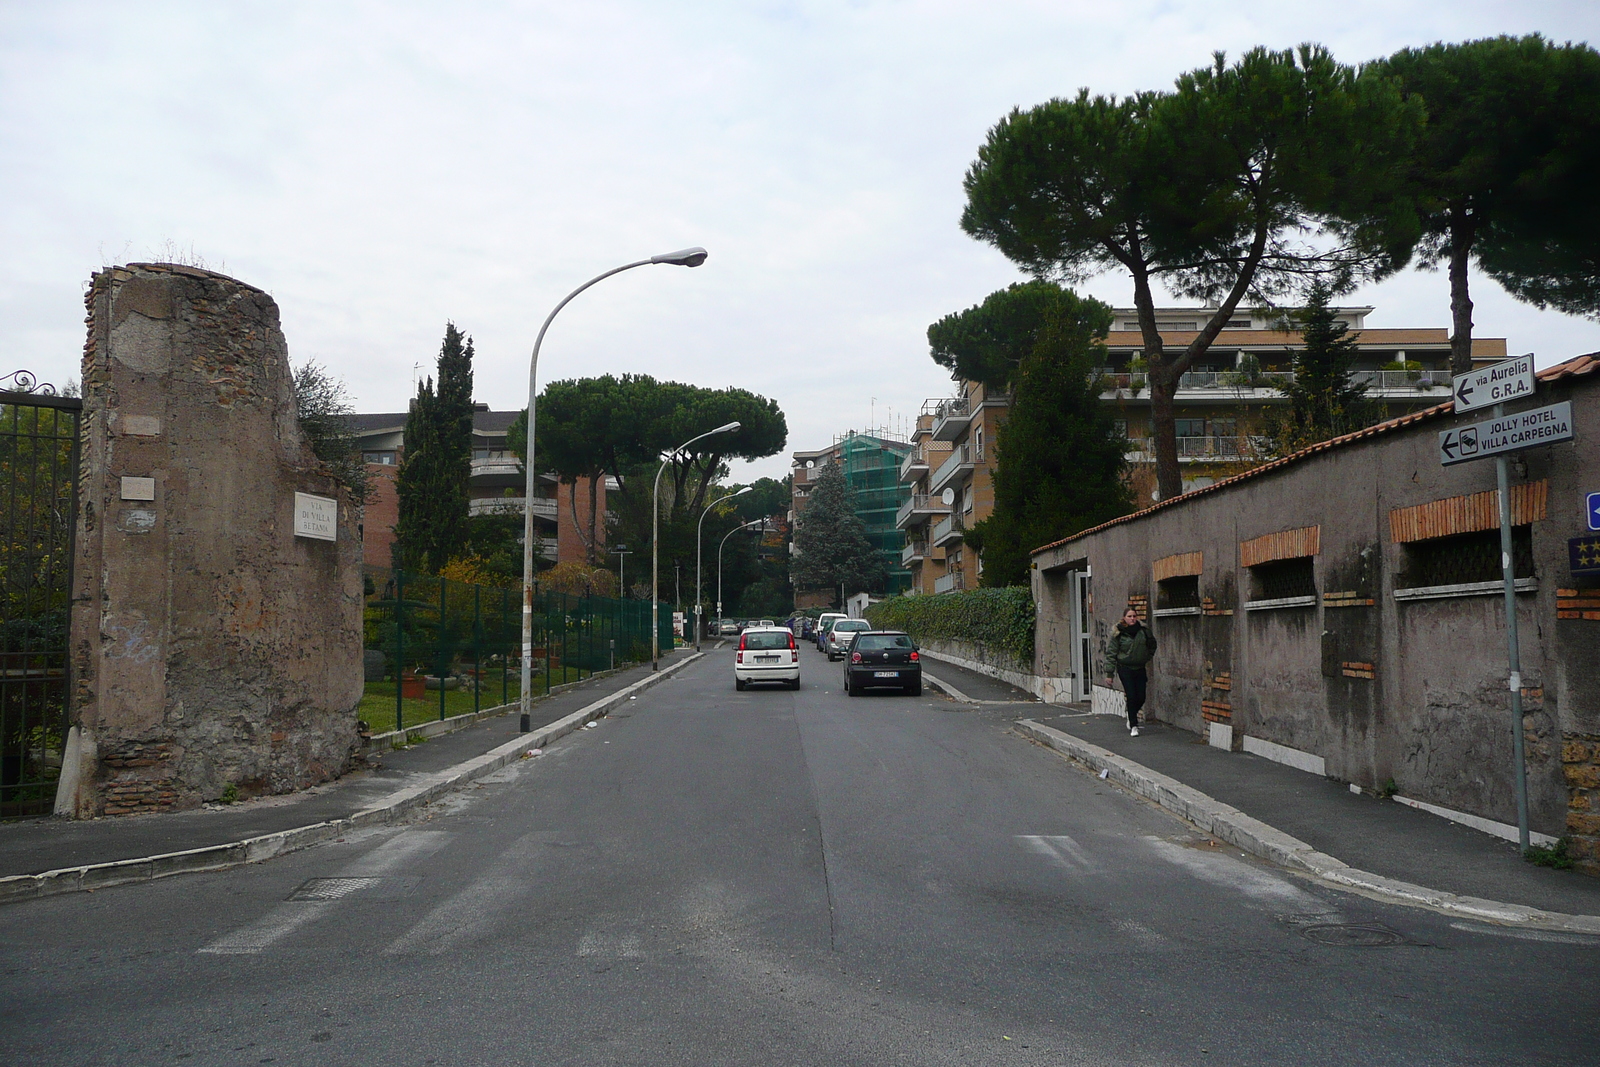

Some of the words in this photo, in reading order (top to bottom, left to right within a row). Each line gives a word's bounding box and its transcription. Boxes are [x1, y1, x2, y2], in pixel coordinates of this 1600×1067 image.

[1476, 375, 1488, 386] via
[1490, 361, 1528, 382] Aurelia
[1491, 380, 1529, 399] G.R.A.
[1490, 419, 1518, 434] JOLLY
[1522, 410, 1556, 427] HOTEL
[1481, 435, 1509, 450] VILLA
[1511, 422, 1568, 443] CARPEGNA
[302, 510, 309, 519] DI
[311, 512, 331, 523] VILLA
[310, 501, 323, 511] VIA
